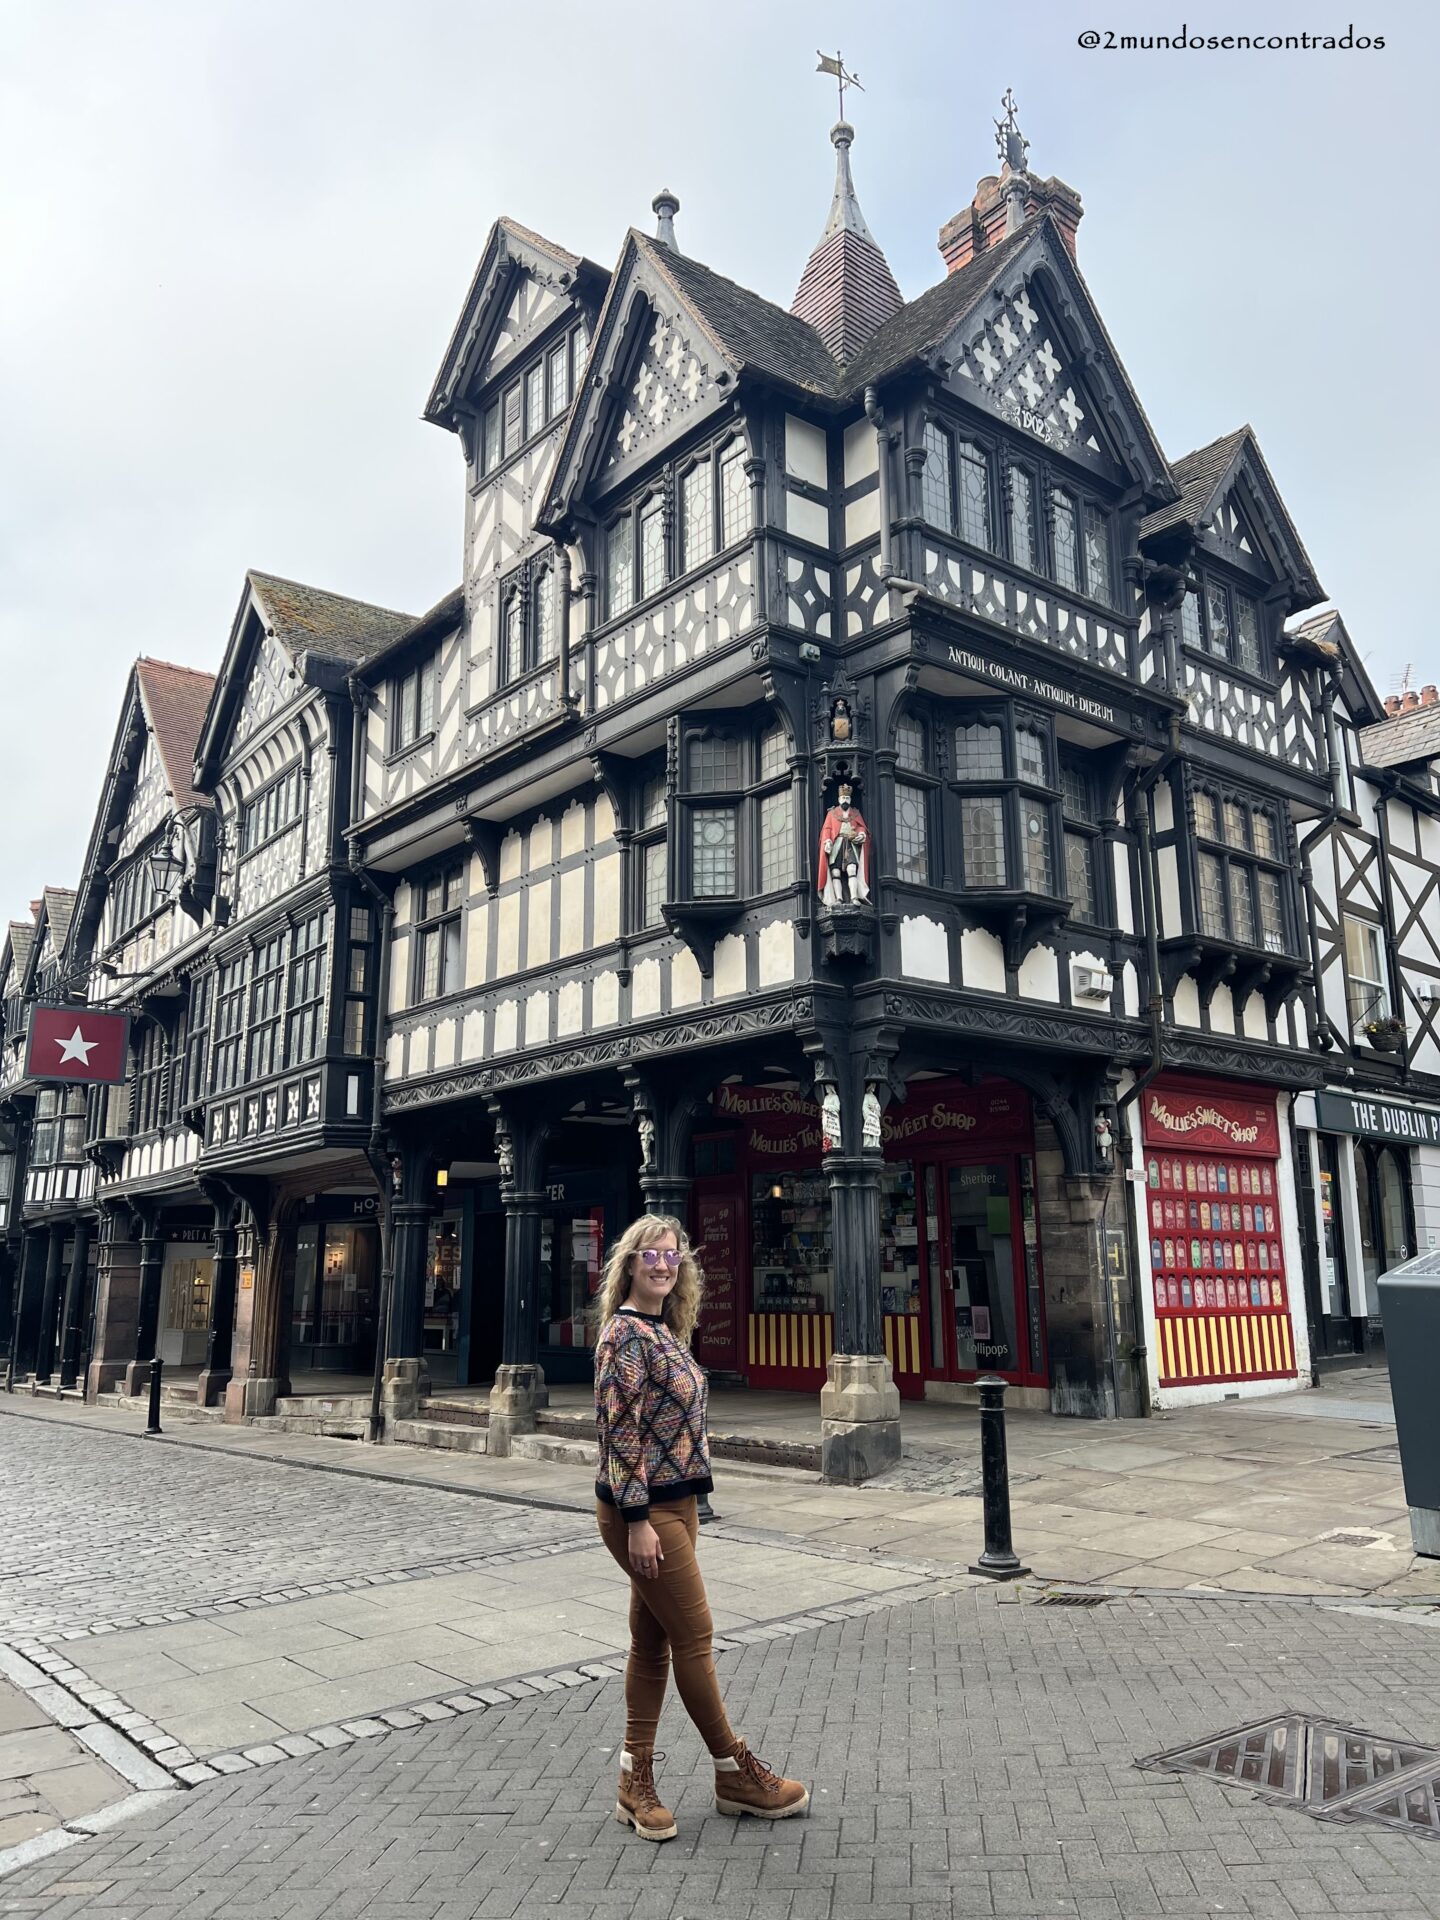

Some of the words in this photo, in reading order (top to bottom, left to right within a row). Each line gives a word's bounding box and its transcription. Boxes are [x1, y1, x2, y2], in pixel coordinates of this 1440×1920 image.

[1021, 409, 1046, 439] 1902
[948, 646, 986, 673] ANTIQUI
[989, 663, 1029, 689] COLANT
[1079, 697, 1114, 722] DIERUM
[880, 1115, 928, 1142] SWEET
[930, 1103, 977, 1131] SHOP
[1195, 1106, 1232, 1134] SWEET
[1231, 1121, 1258, 1143] SHOP
[1351, 1101, 1379, 1131] THE
[1381, 1106, 1428, 1139] DUBLIN
[1430, 1115, 1440, 1140] P
[960, 1172, 997, 1186] Sherbet
[182, 1230, 200, 1241] PRET
[702, 1335, 732, 1346] CANDY
[966, 1341, 1009, 1357] Lollipops
